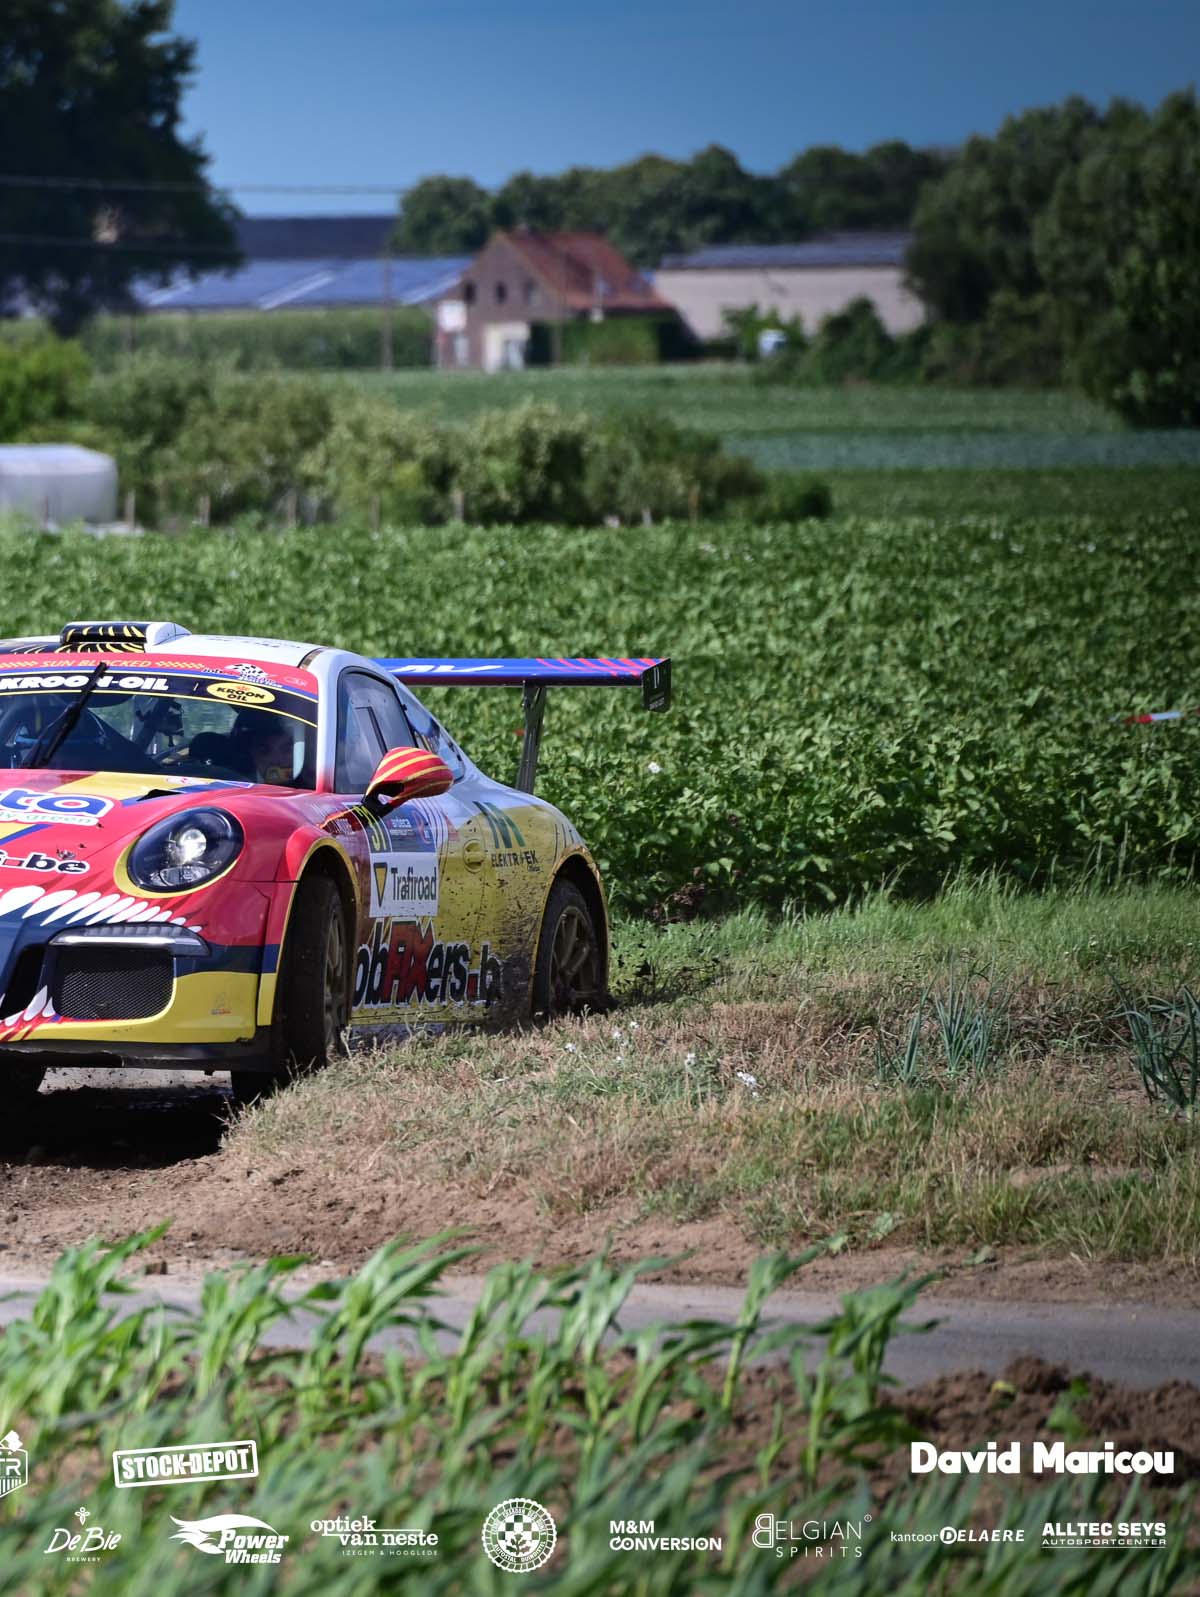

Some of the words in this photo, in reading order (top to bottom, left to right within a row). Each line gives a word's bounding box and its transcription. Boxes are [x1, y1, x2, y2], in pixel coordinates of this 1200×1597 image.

[40, 659, 75, 668] SUN
[216, 686, 265, 700] KROON
[227, 694, 248, 702] OIL
[390, 866, 437, 901] Trafiroad
